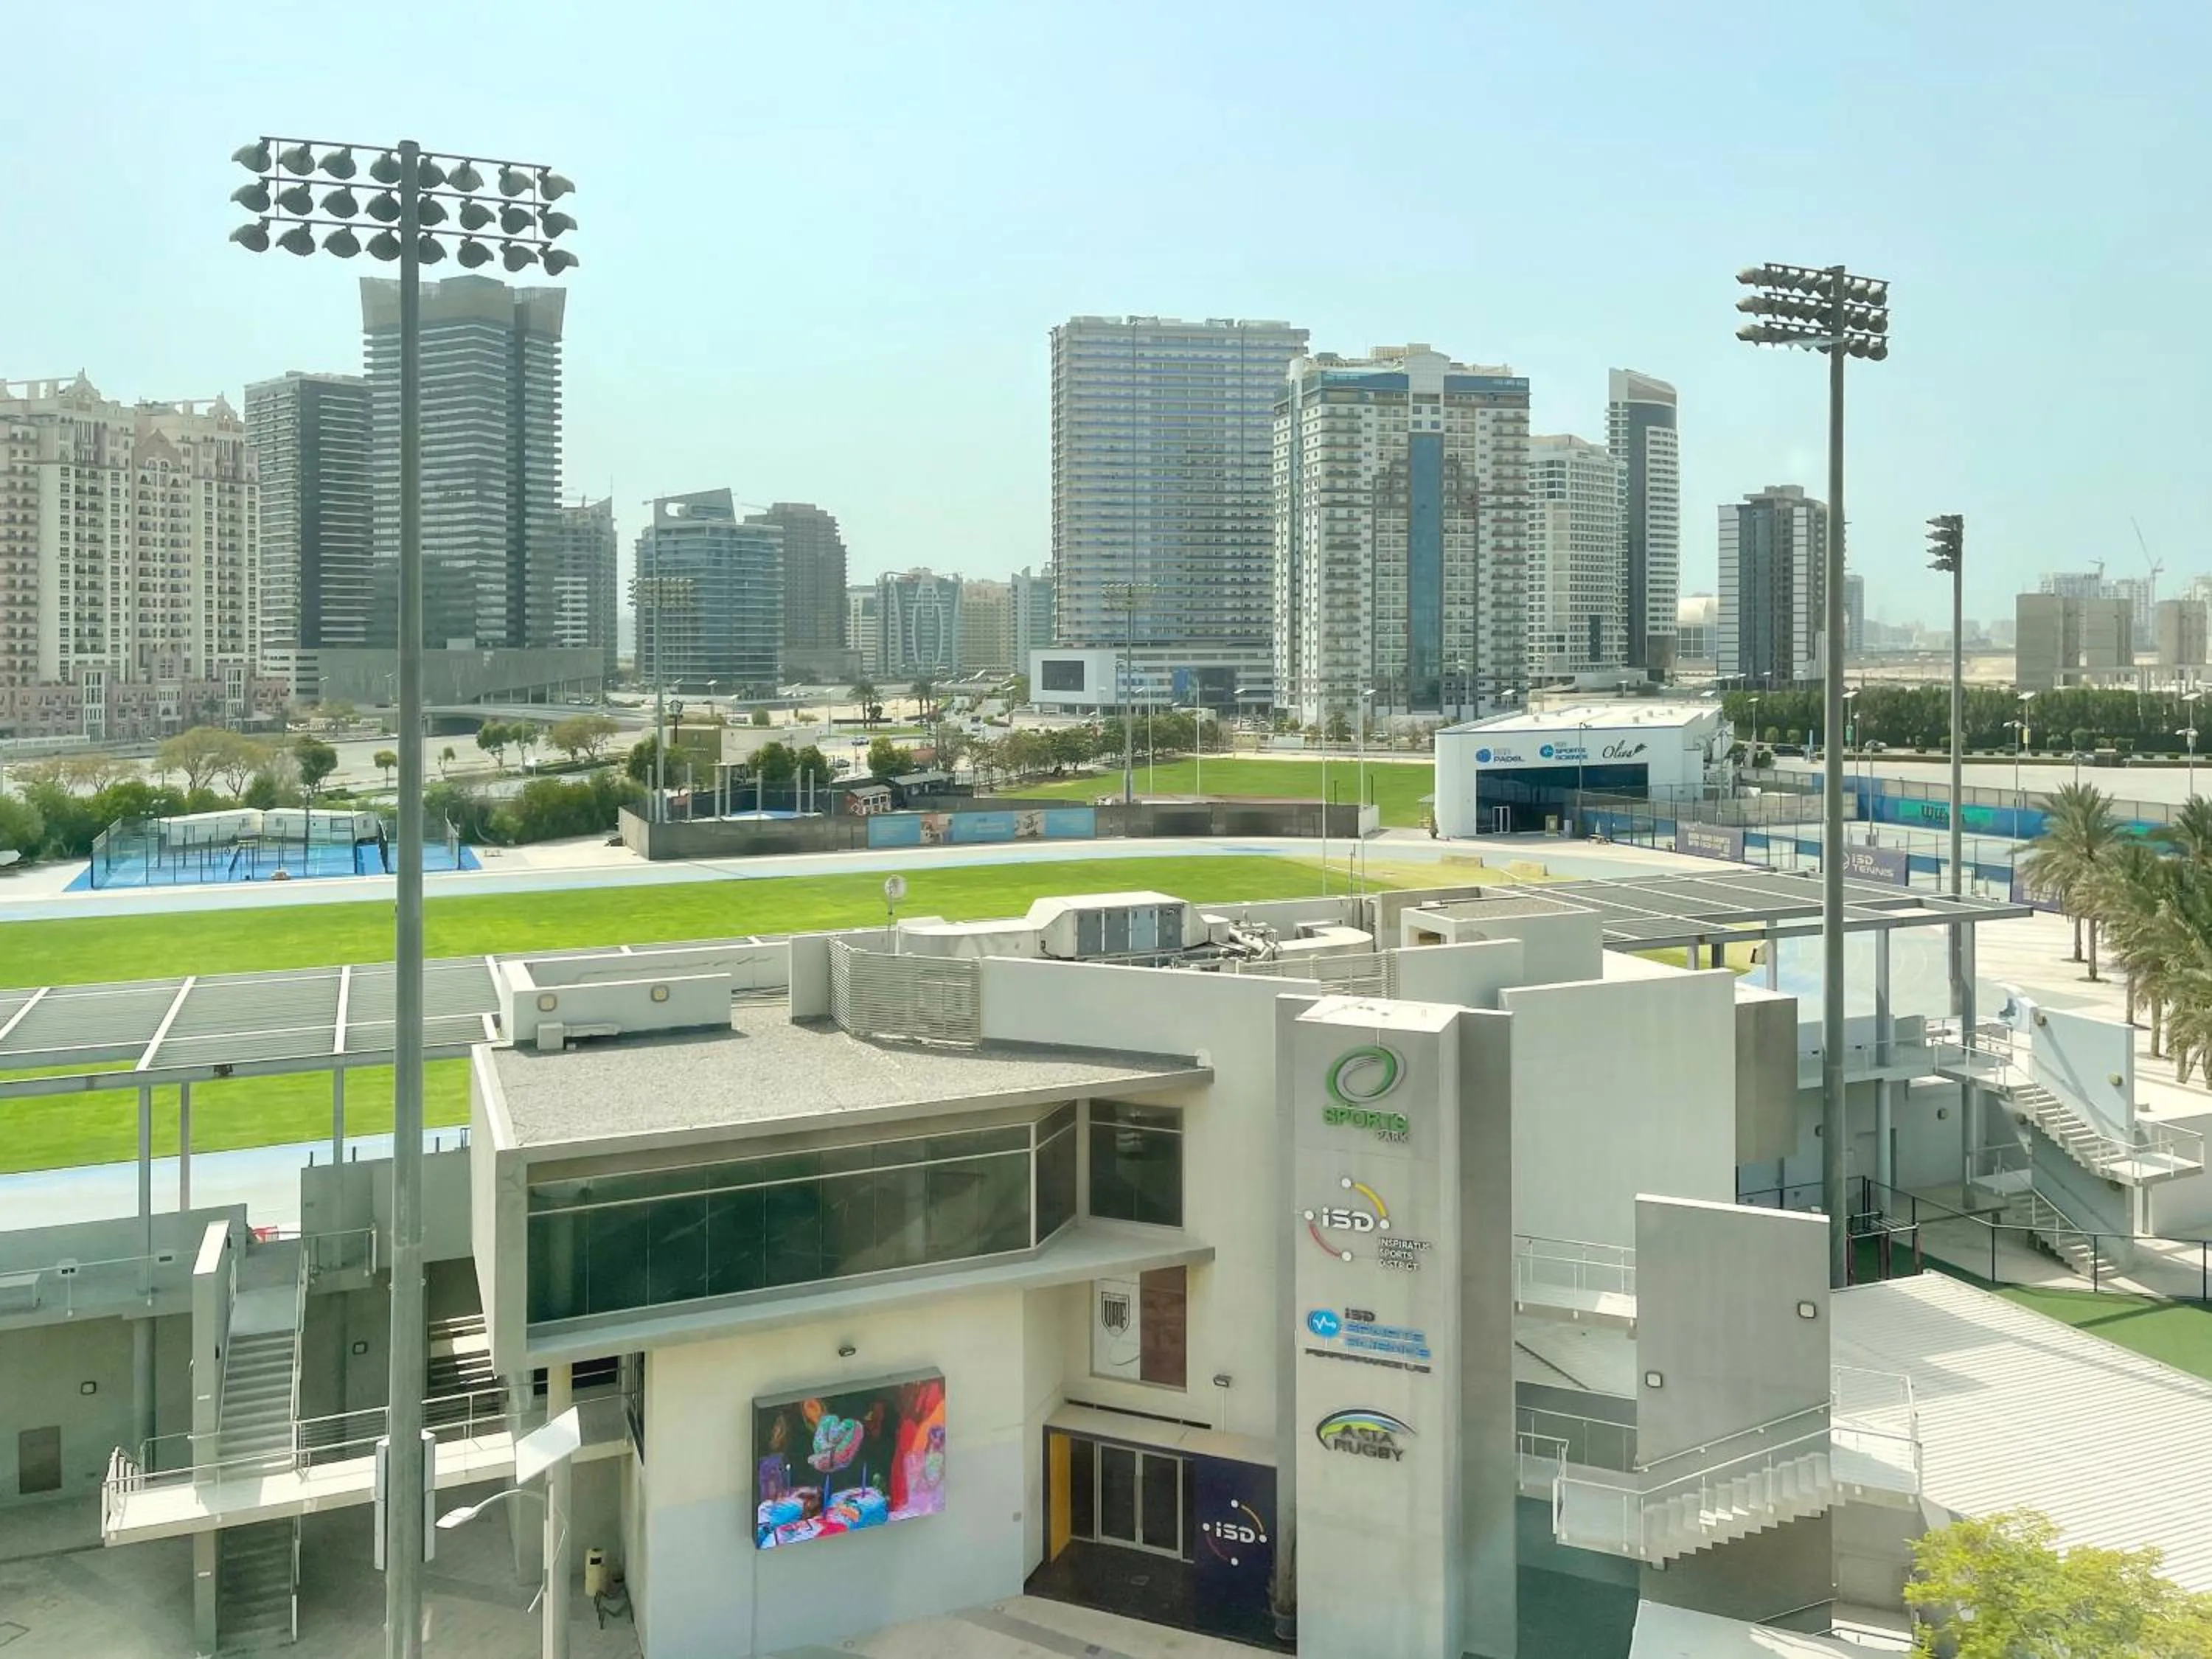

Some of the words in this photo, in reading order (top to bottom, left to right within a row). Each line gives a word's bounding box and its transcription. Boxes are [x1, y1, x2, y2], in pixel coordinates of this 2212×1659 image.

[1851, 863, 1894, 877] TENNIS
[1323, 1105, 1409, 1133] SPORTS
[1380, 1248, 1414, 1260] SPORTS
[1340, 1425, 1395, 1446] ASIA
[1335, 1439, 1404, 1462] RUGBY
